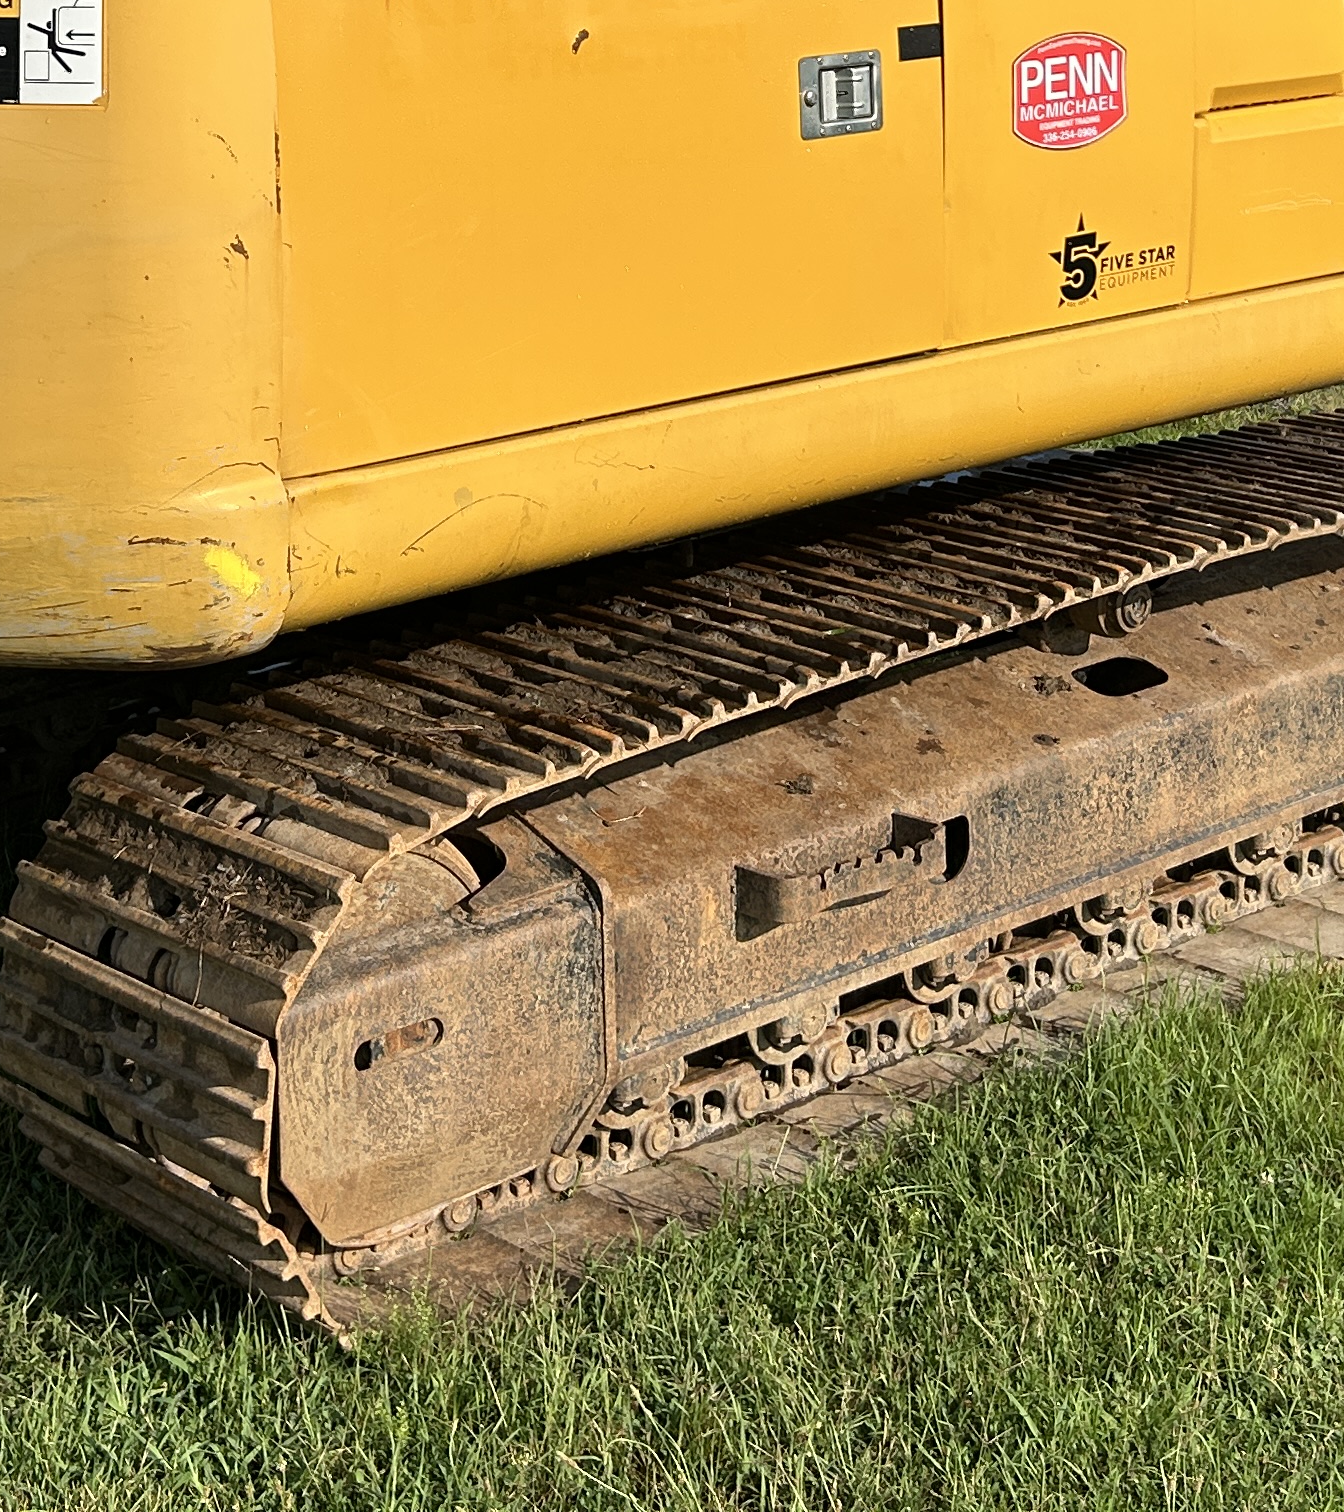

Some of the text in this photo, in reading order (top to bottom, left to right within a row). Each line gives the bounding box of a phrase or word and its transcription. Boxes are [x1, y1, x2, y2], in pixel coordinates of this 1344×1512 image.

[1020, 49, 1118, 104] PENN
[1019, 94, 1119, 122] MCMICHAEL
[1059, 231, 1097, 301] 5
[1100, 245, 1176, 273] FIVE STAR
[1099, 264, 1176, 291] EQUIPMENT
